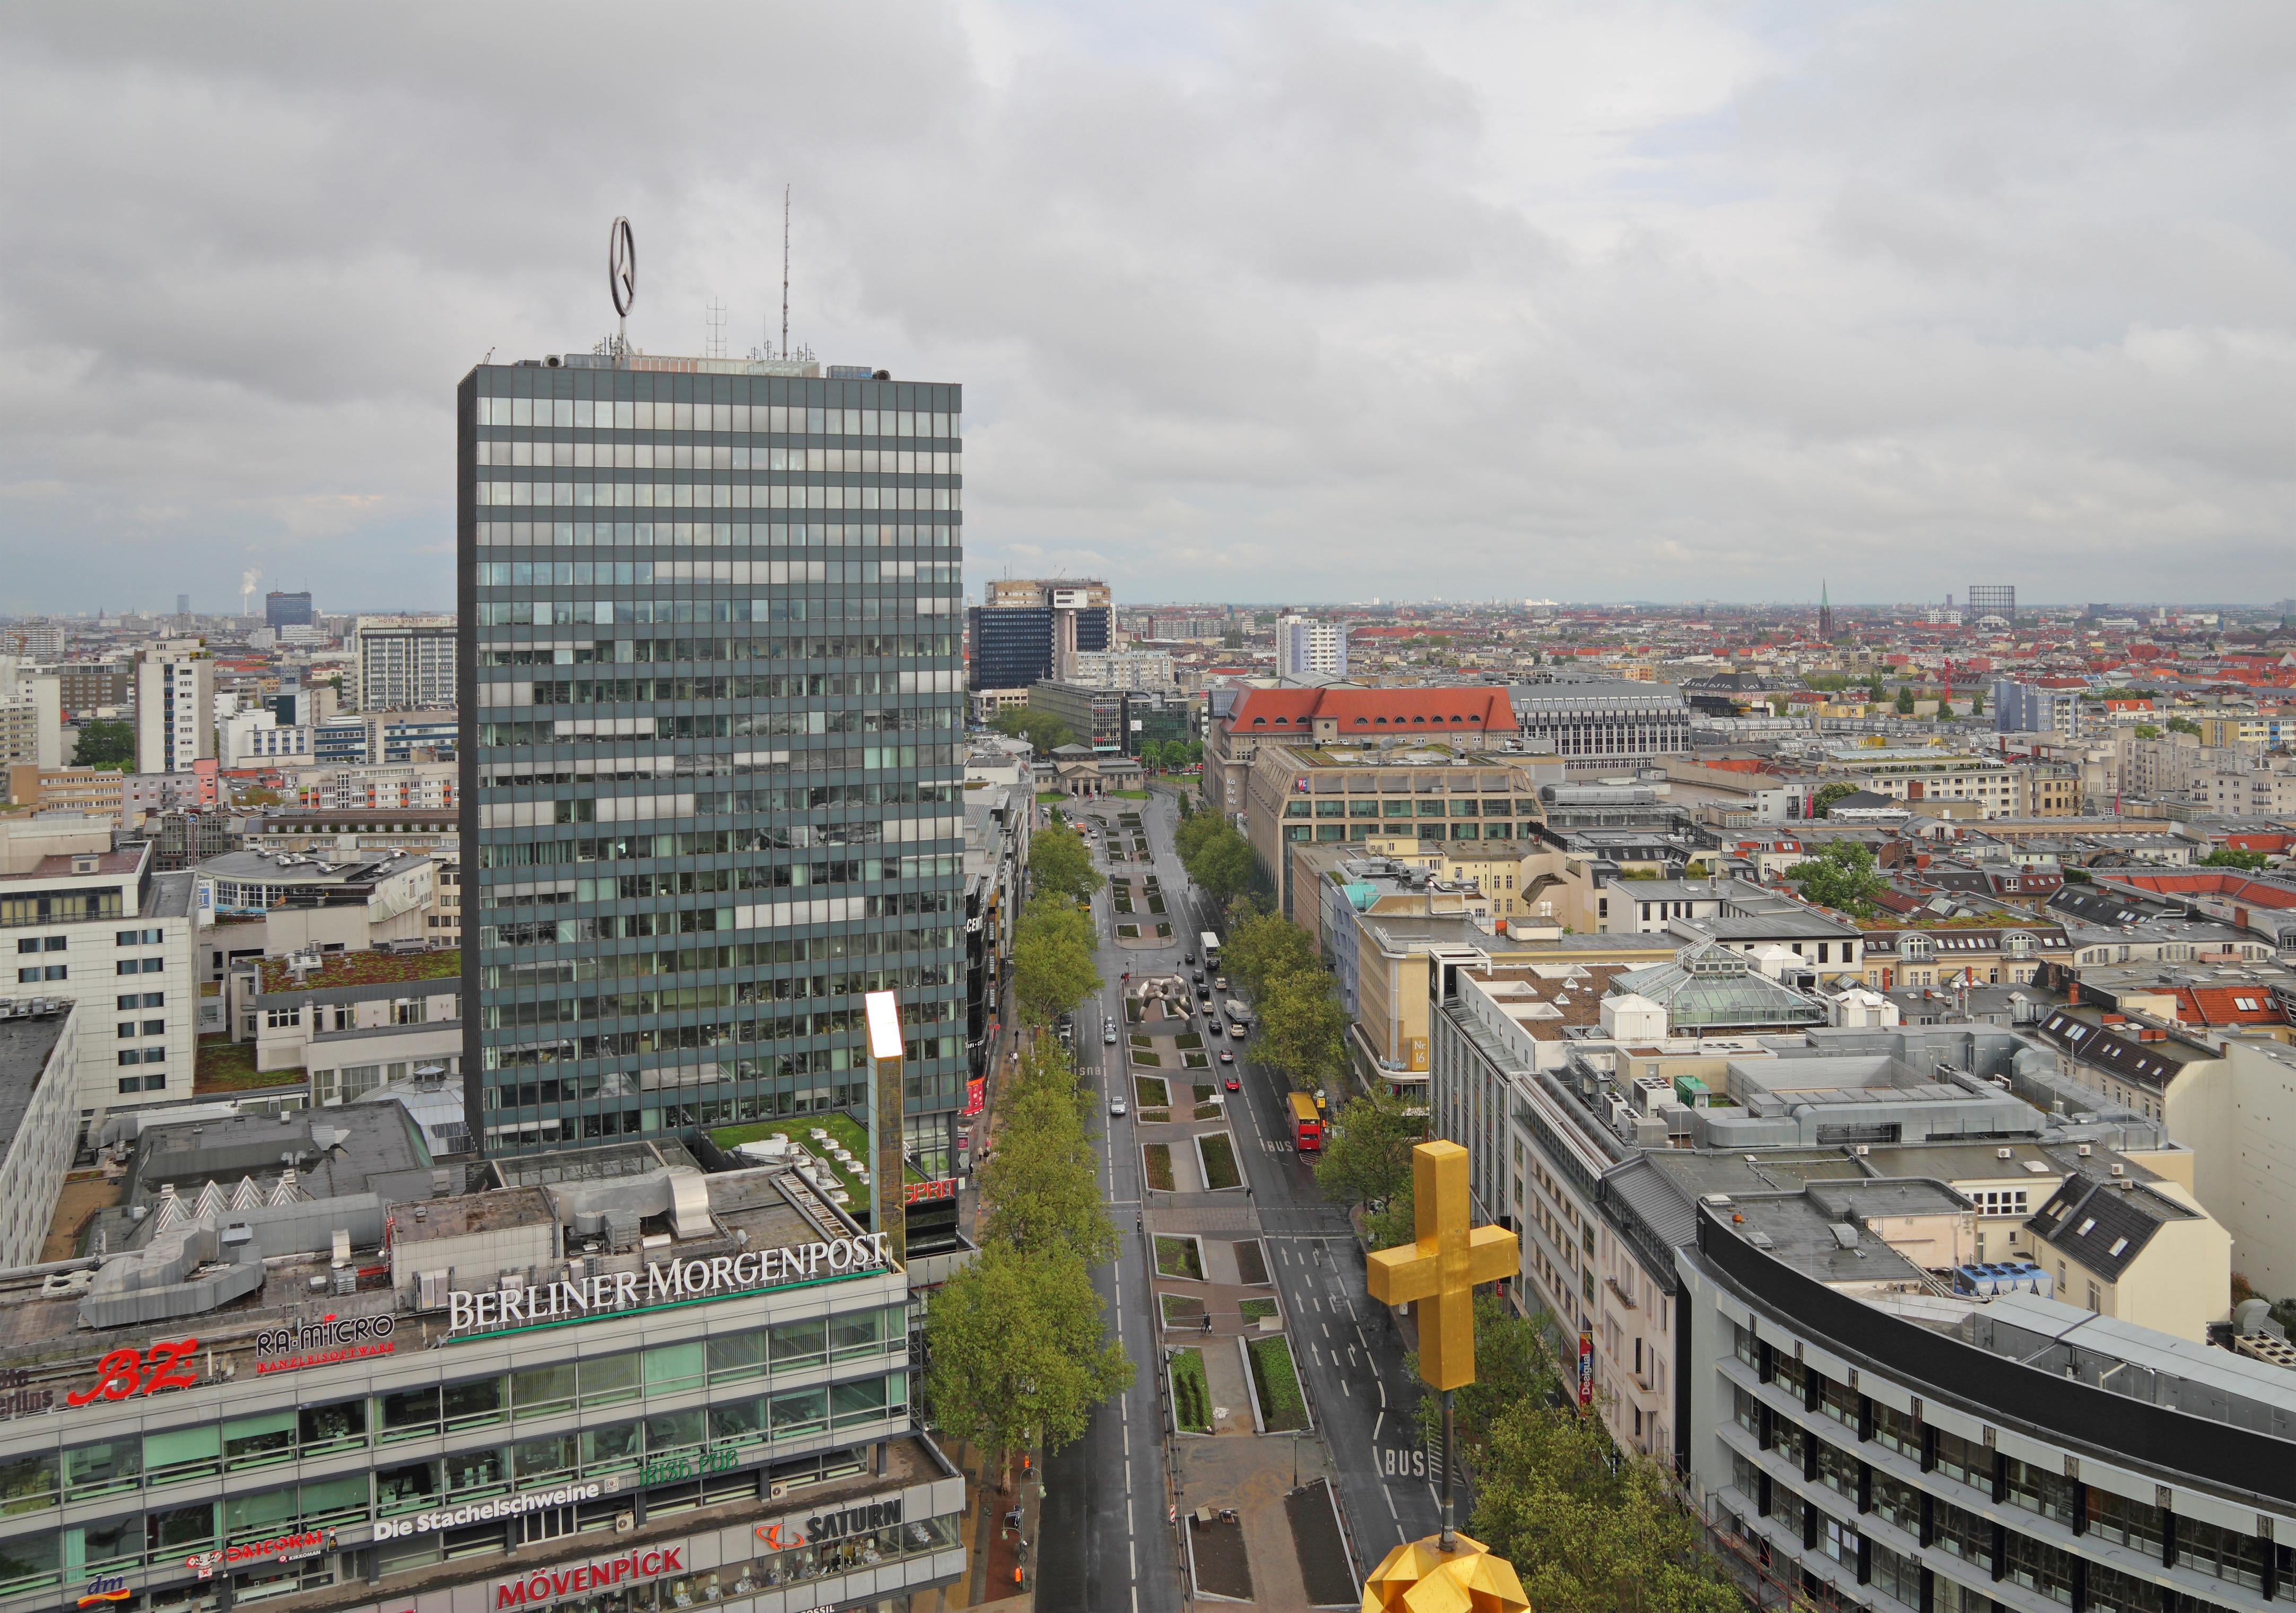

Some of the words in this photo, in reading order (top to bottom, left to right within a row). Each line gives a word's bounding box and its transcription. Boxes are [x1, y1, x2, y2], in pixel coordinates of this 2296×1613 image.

[1414, 1041, 1426, 1050] Nr.
[1416, 1052, 1425, 1063] 16
[1080, 1067, 1101, 1076] BUS
[1267, 1141, 1293, 1152] BUS
[448, 1270, 640, 1332] BERLINER
[646, 1232, 888, 1300] MORGENPOST
[258, 1341, 395, 1373] KANZLEISOFTWARE
[699, 1449, 739, 1475] PUB
[1386, 1449, 1424, 1477] BUS
[373, 1519, 413, 1542] Die
[417, 1484, 599, 1532] Stachelschweine
[807, 1497, 901, 1543] SATURN
[227, 1528, 322, 1562] DAITOKAI
[289, 1549, 321, 1561] KIKKOMAN
[87, 1573, 124, 1595] dm
[800, 1605, 835, 1613] OSSIL
